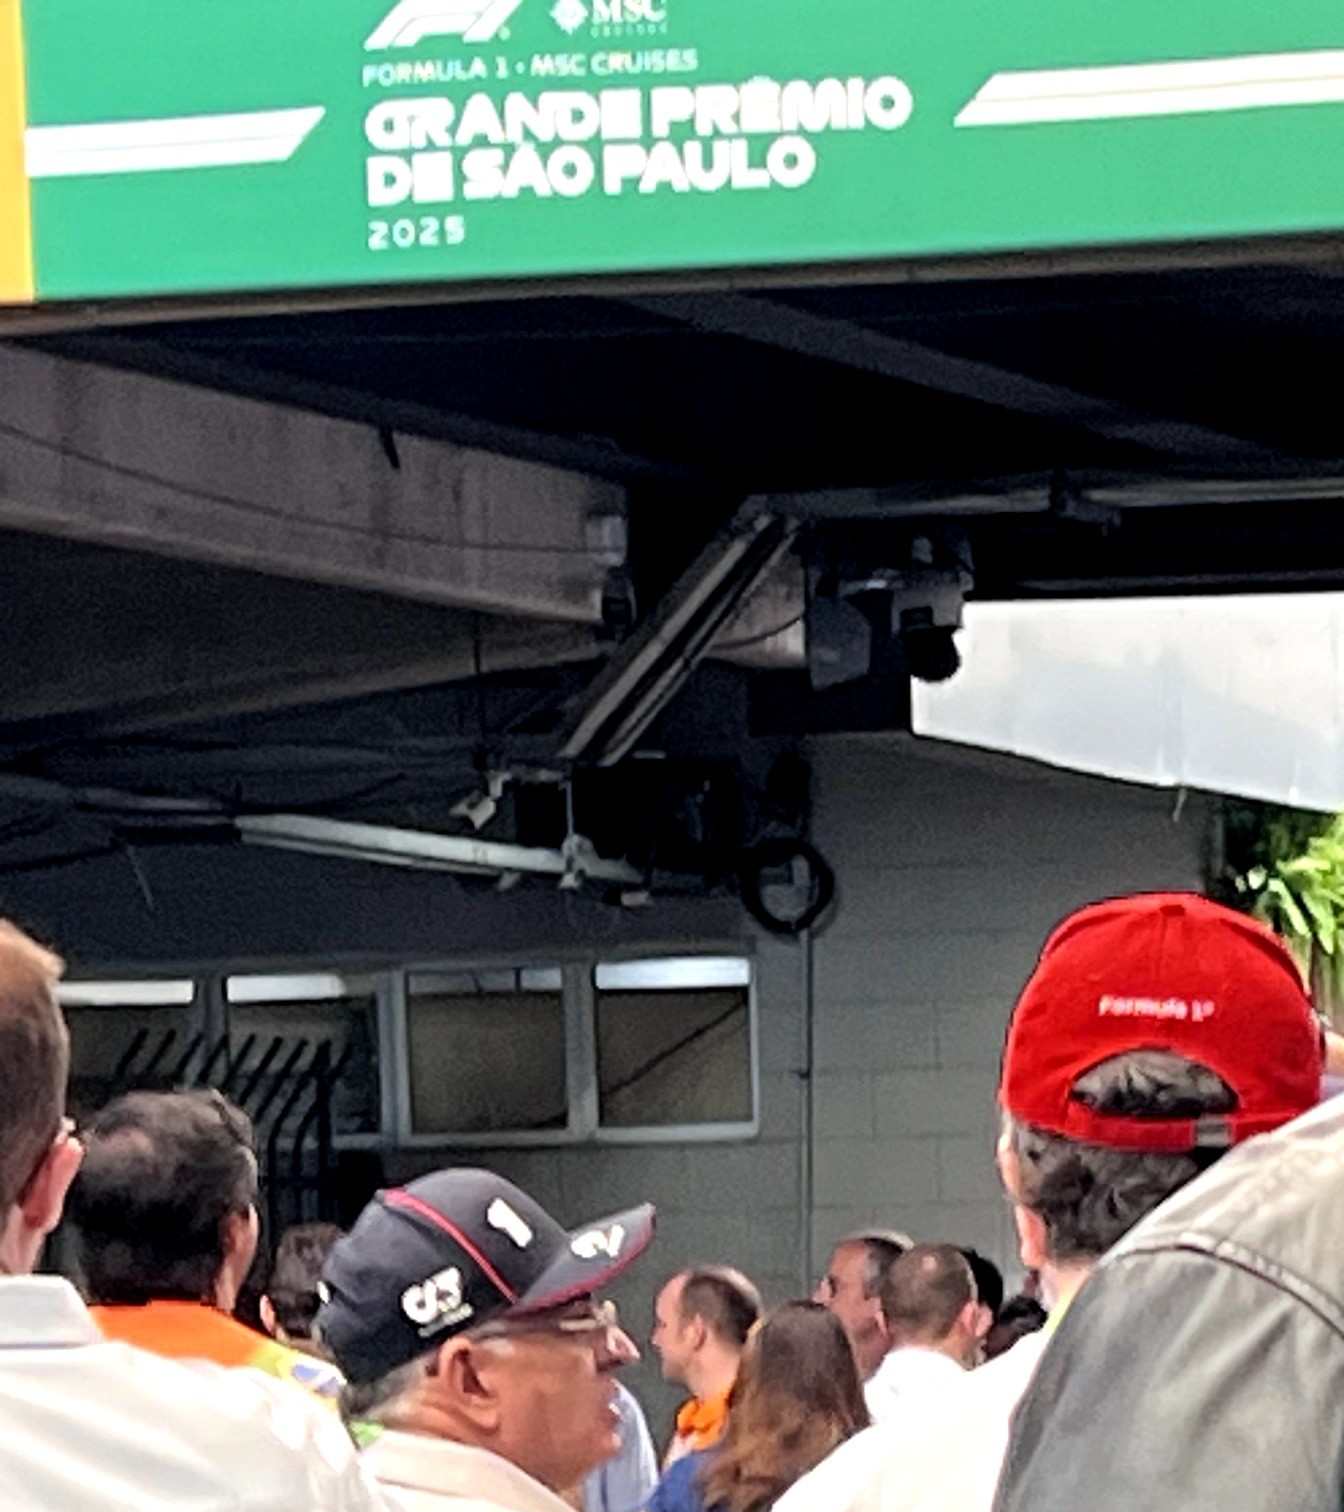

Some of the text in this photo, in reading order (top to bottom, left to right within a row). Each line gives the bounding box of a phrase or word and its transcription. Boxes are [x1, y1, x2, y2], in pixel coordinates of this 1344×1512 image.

[362, 48, 699, 87] FORMULA 1 MSC CRUISES
[364, 75, 914, 150] GRANDE PRÊMIO
[366, 134, 817, 207] DE SÃO PAULO
[367, 215, 466, 251] 2025
